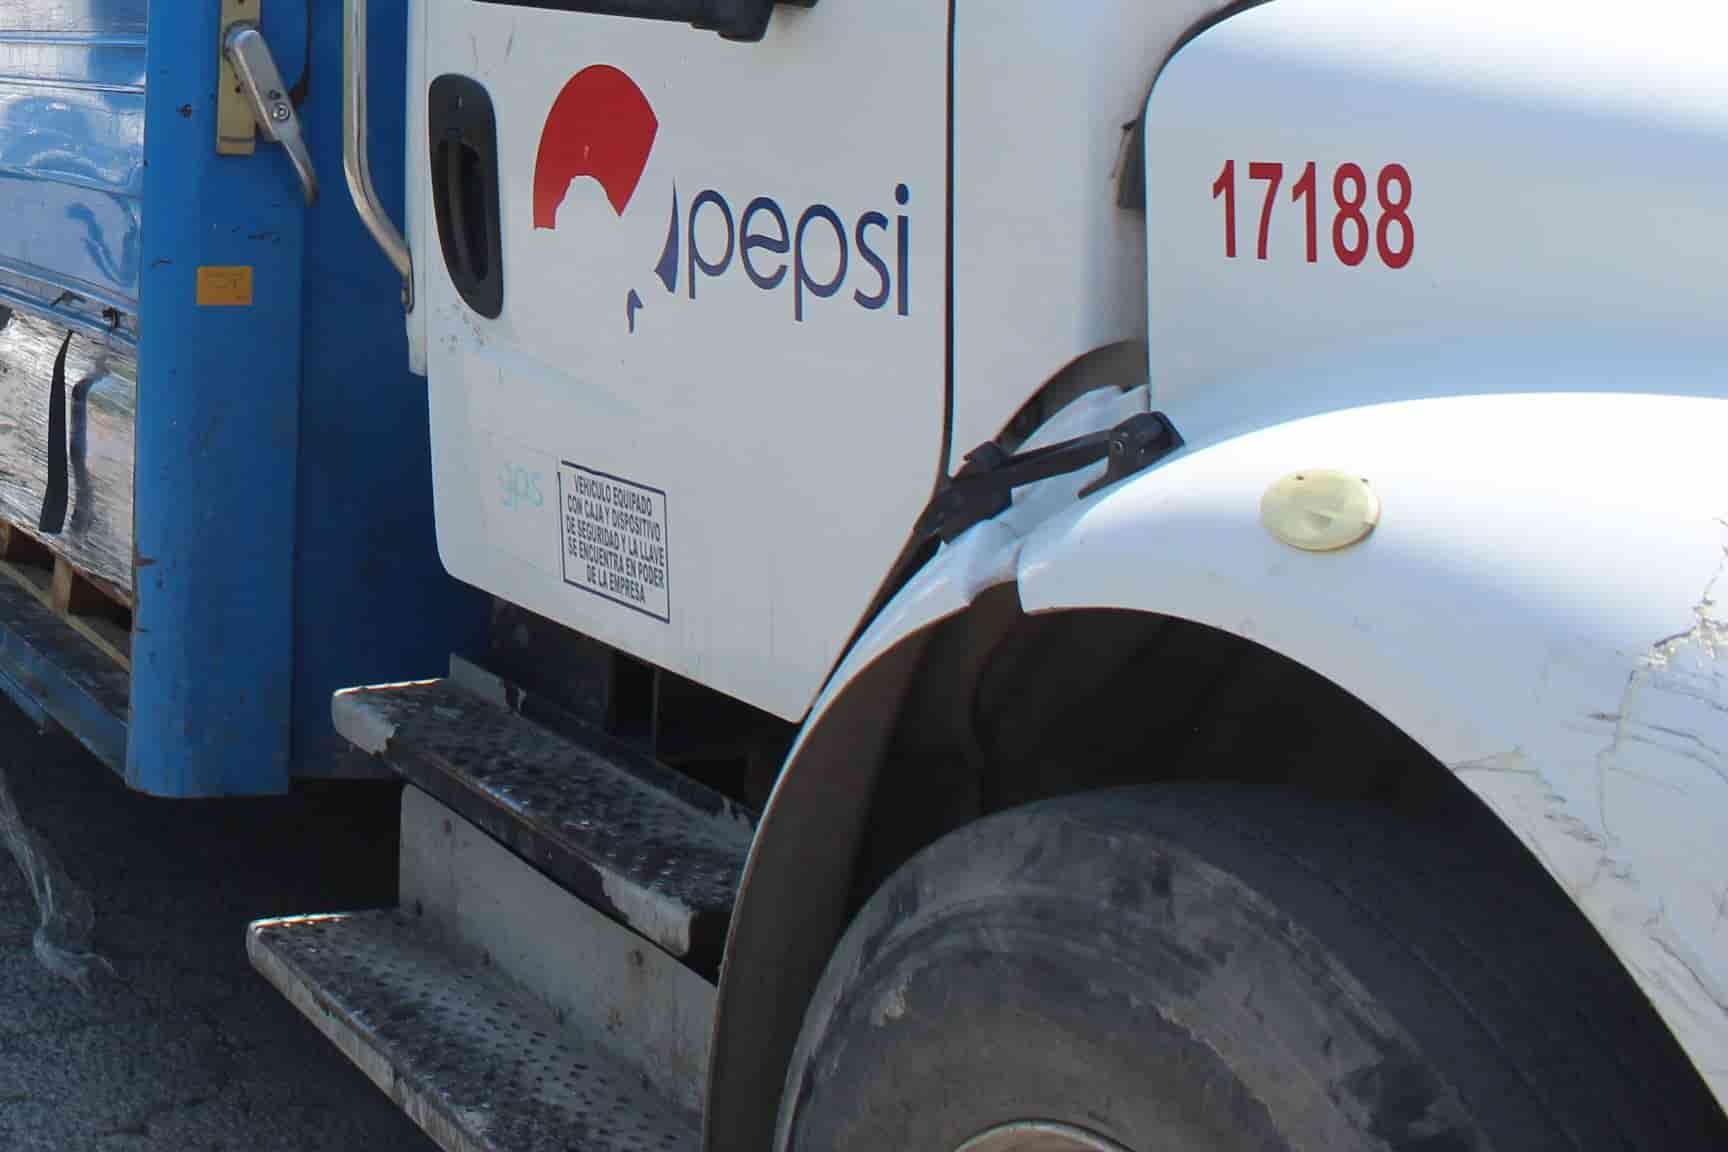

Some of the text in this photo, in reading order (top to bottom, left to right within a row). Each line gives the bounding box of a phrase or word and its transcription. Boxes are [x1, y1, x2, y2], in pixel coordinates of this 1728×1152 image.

[1212, 159, 1415, 269] 17188
[688, 183, 910, 322] pepsi
[568, 494, 661, 543] CON CAJA Y DISPOSITIVO
[574, 473, 652, 517] VEHICULO EQUIPADO
[566, 515, 665, 567] DE SEGURIDAD Y LA LLAVE
[567, 536, 664, 589] SE ENCUENTRA EN PODER
[586, 564, 646, 605] DE LA EMPRESA
